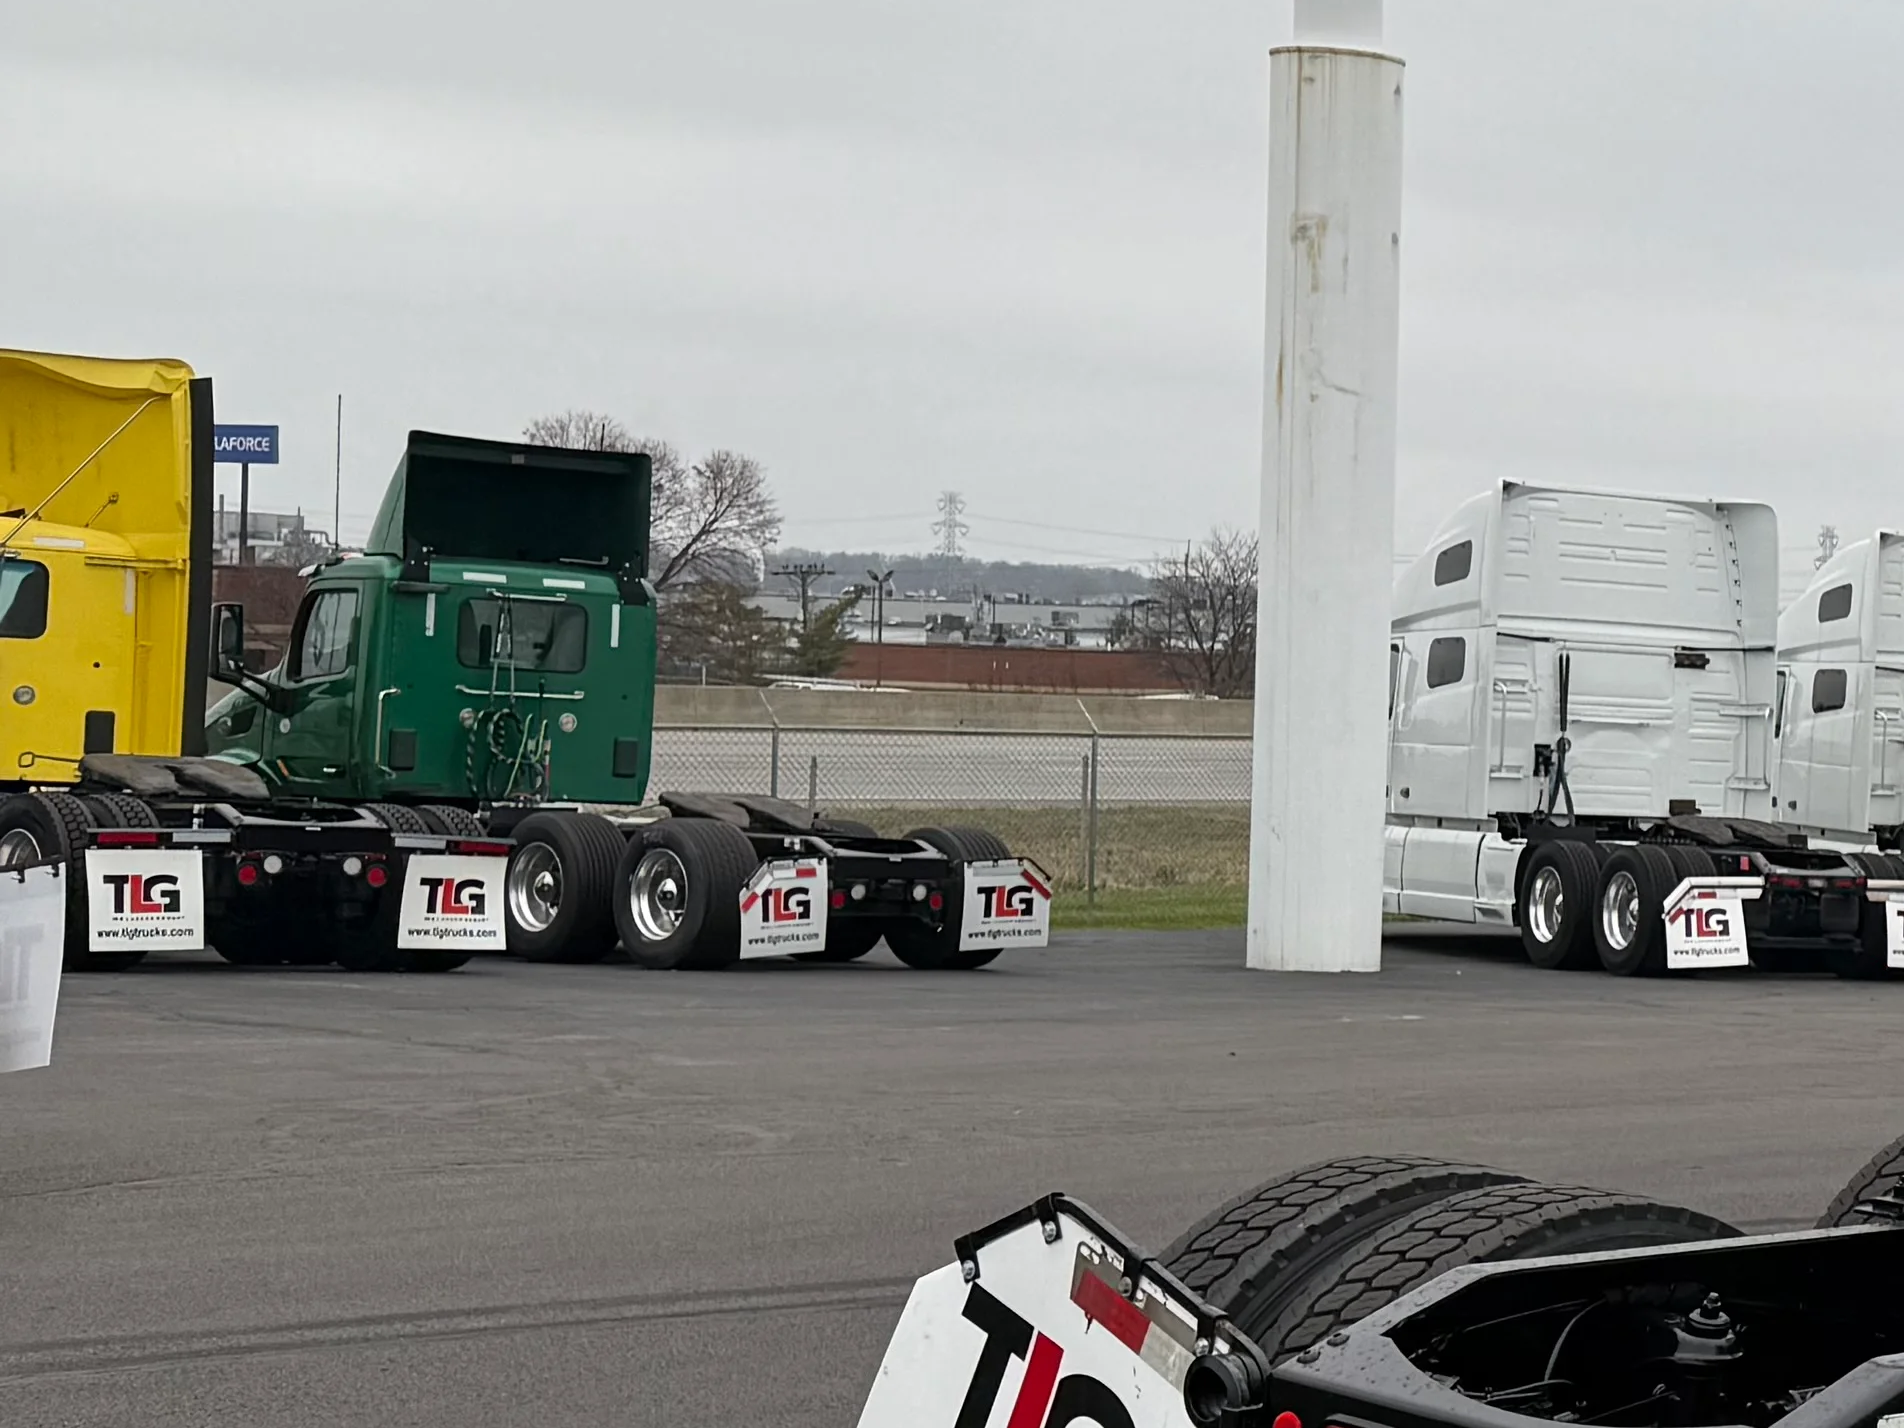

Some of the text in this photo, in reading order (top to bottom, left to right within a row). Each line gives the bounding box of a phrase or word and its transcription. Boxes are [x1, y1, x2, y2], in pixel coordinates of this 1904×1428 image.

[103, 874, 181, 914] TLG
[420, 877, 486, 916] TLG
[761, 886, 811, 923] TLG
[977, 885, 1034, 918] TLG
[1683, 907, 1730, 938] TLG
